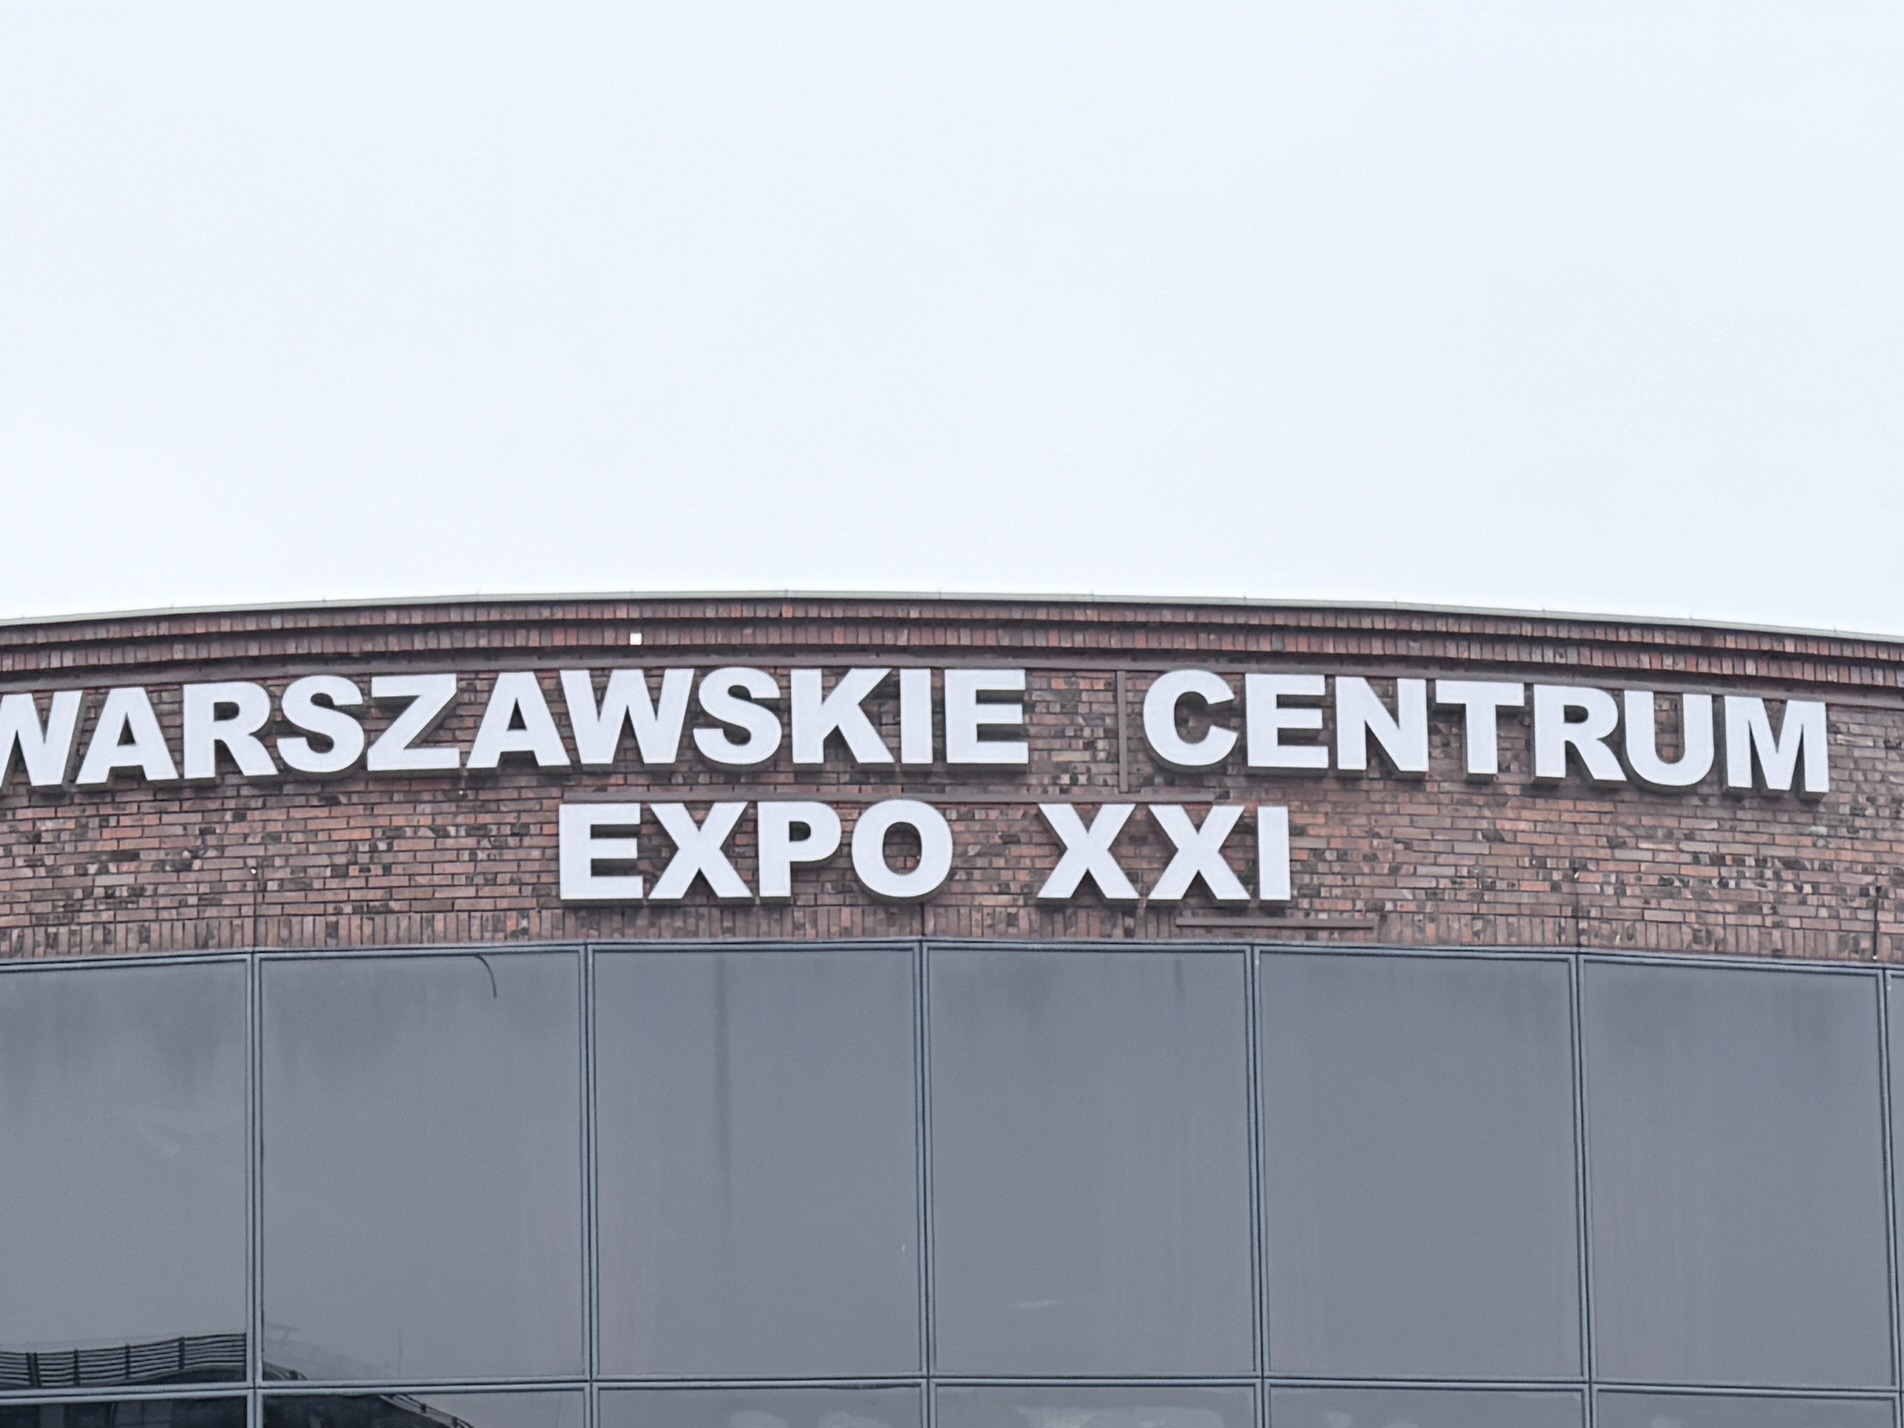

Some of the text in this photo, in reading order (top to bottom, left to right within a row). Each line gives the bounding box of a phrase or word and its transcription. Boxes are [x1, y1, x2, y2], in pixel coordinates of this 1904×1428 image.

[1142, 668, 1832, 796] CENTRUM
[558, 800, 1290, 906] EXPO XXI
